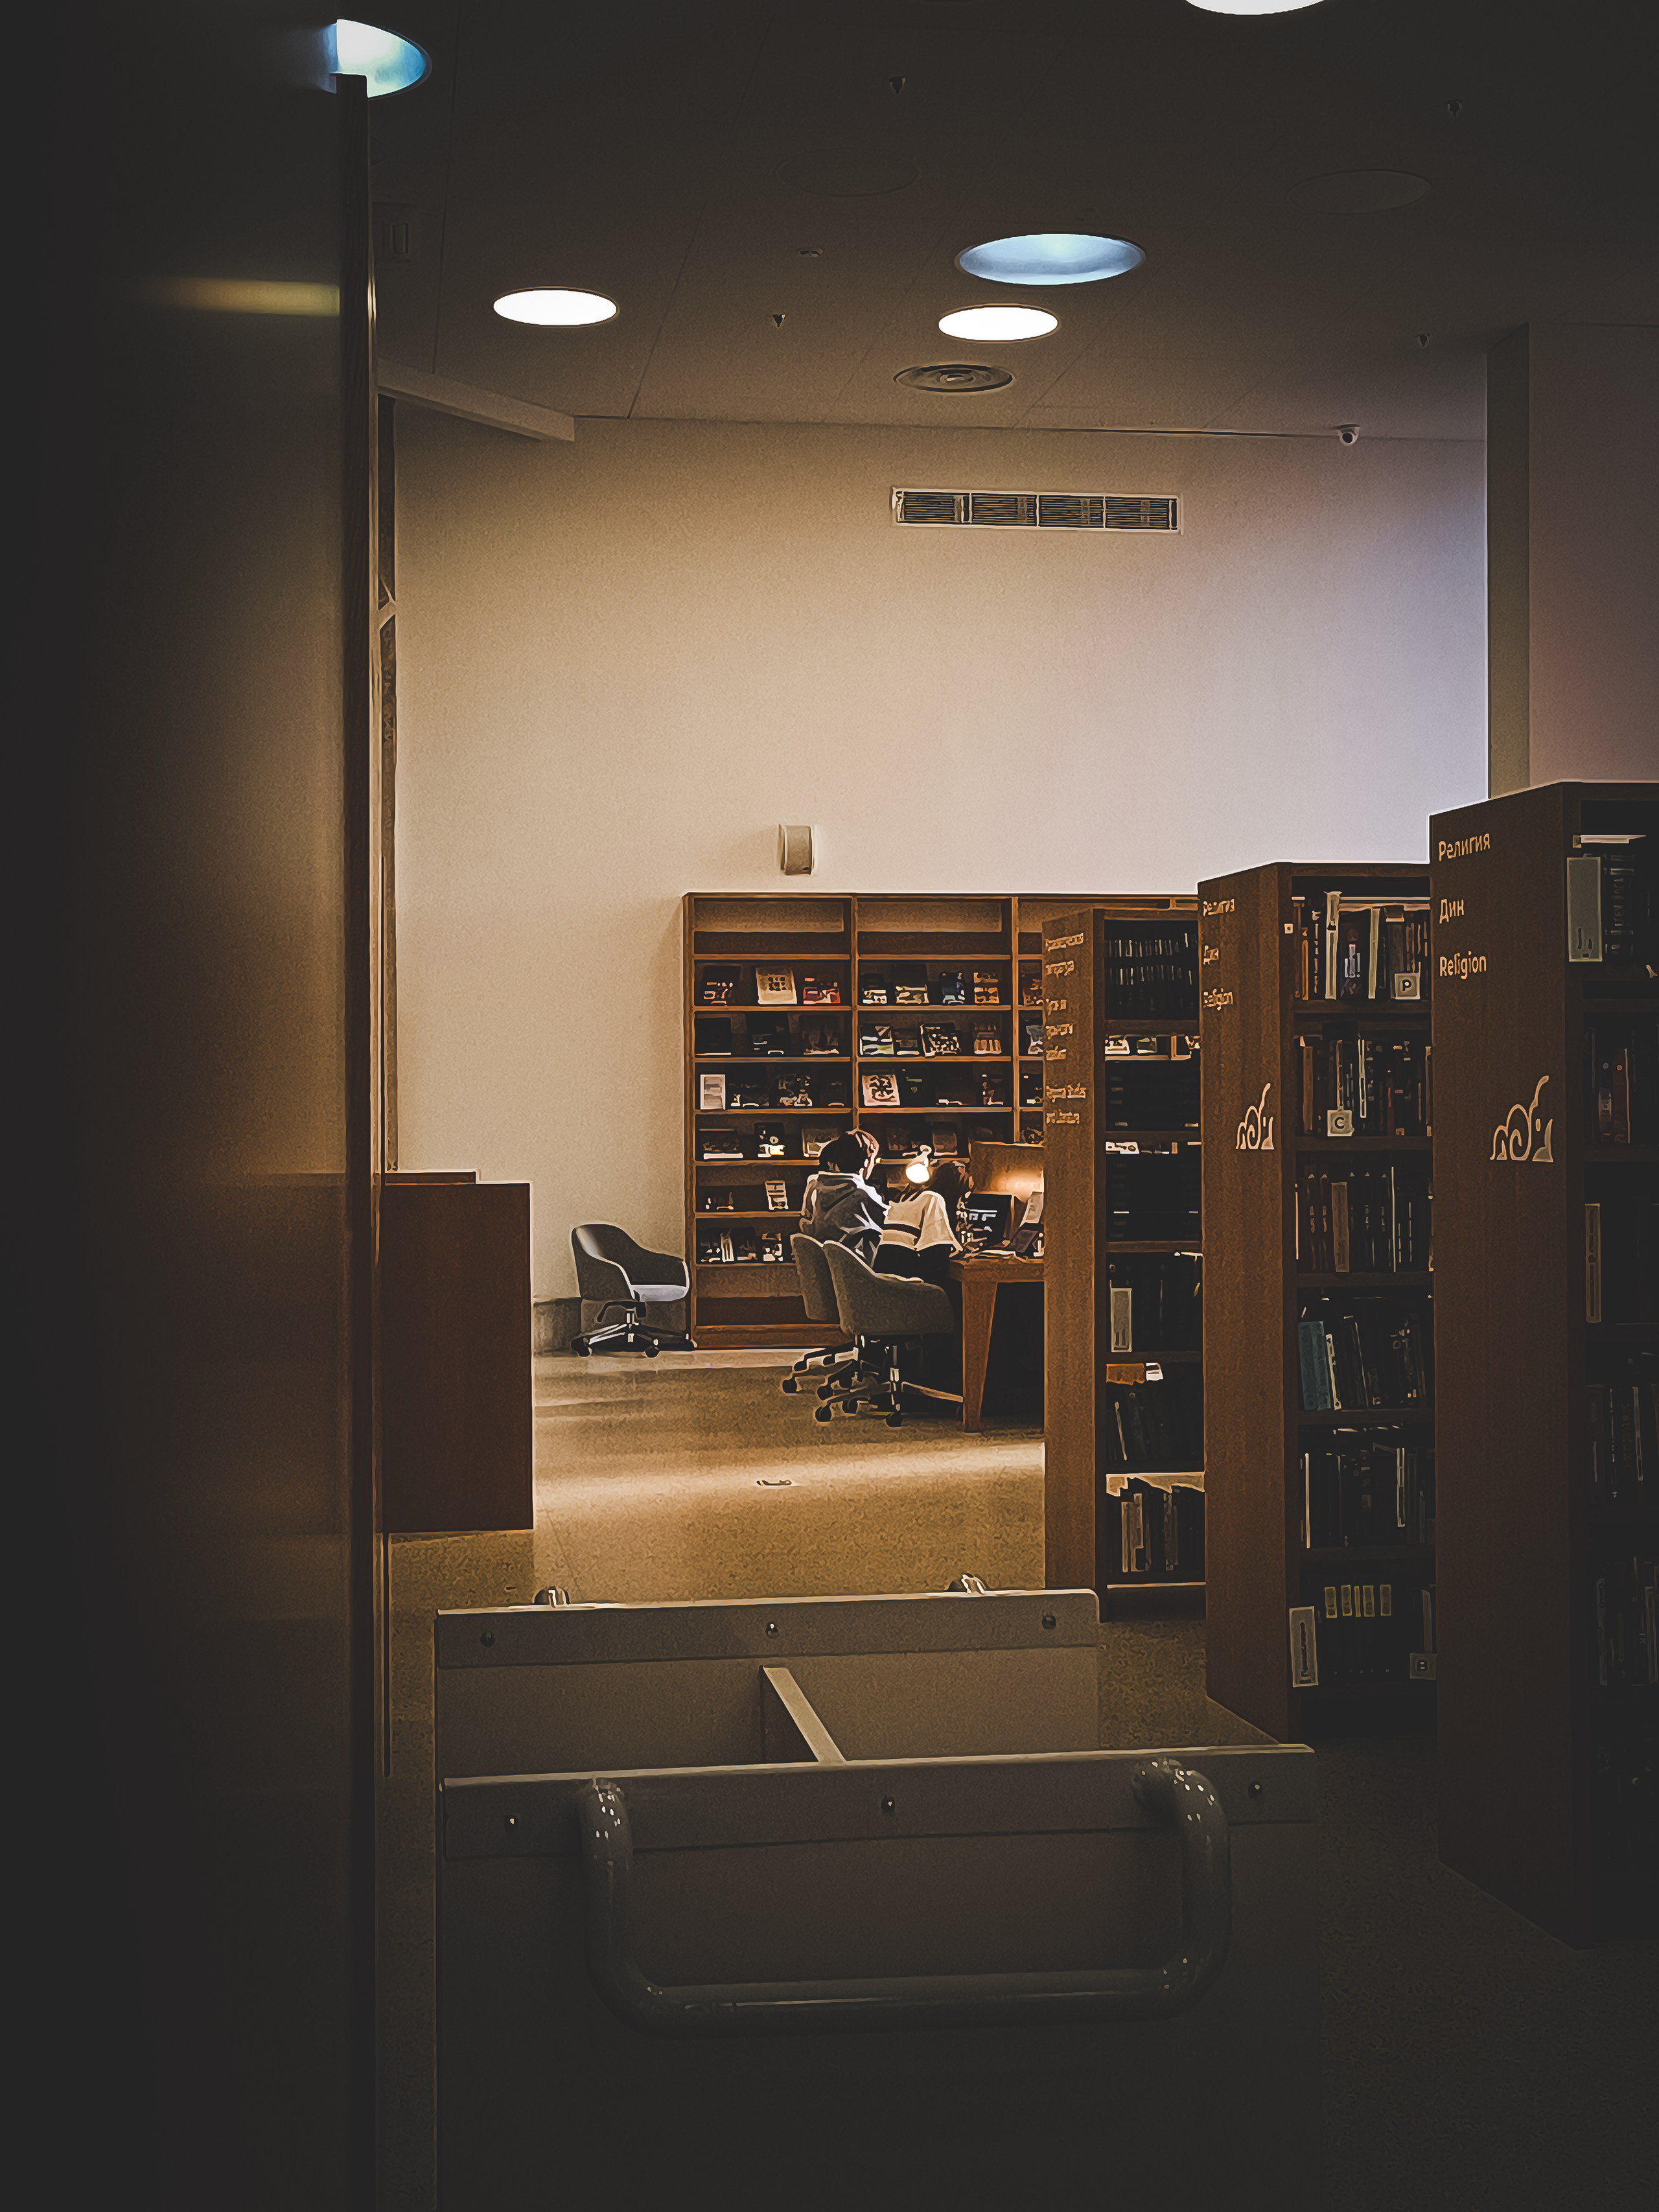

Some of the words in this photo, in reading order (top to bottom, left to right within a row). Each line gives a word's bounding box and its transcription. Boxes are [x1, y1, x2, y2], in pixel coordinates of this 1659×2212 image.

[1439, 833, 1491, 862] Религия
[1439, 898, 1465, 924] Дин
[1439, 950, 1487, 980] Religion
